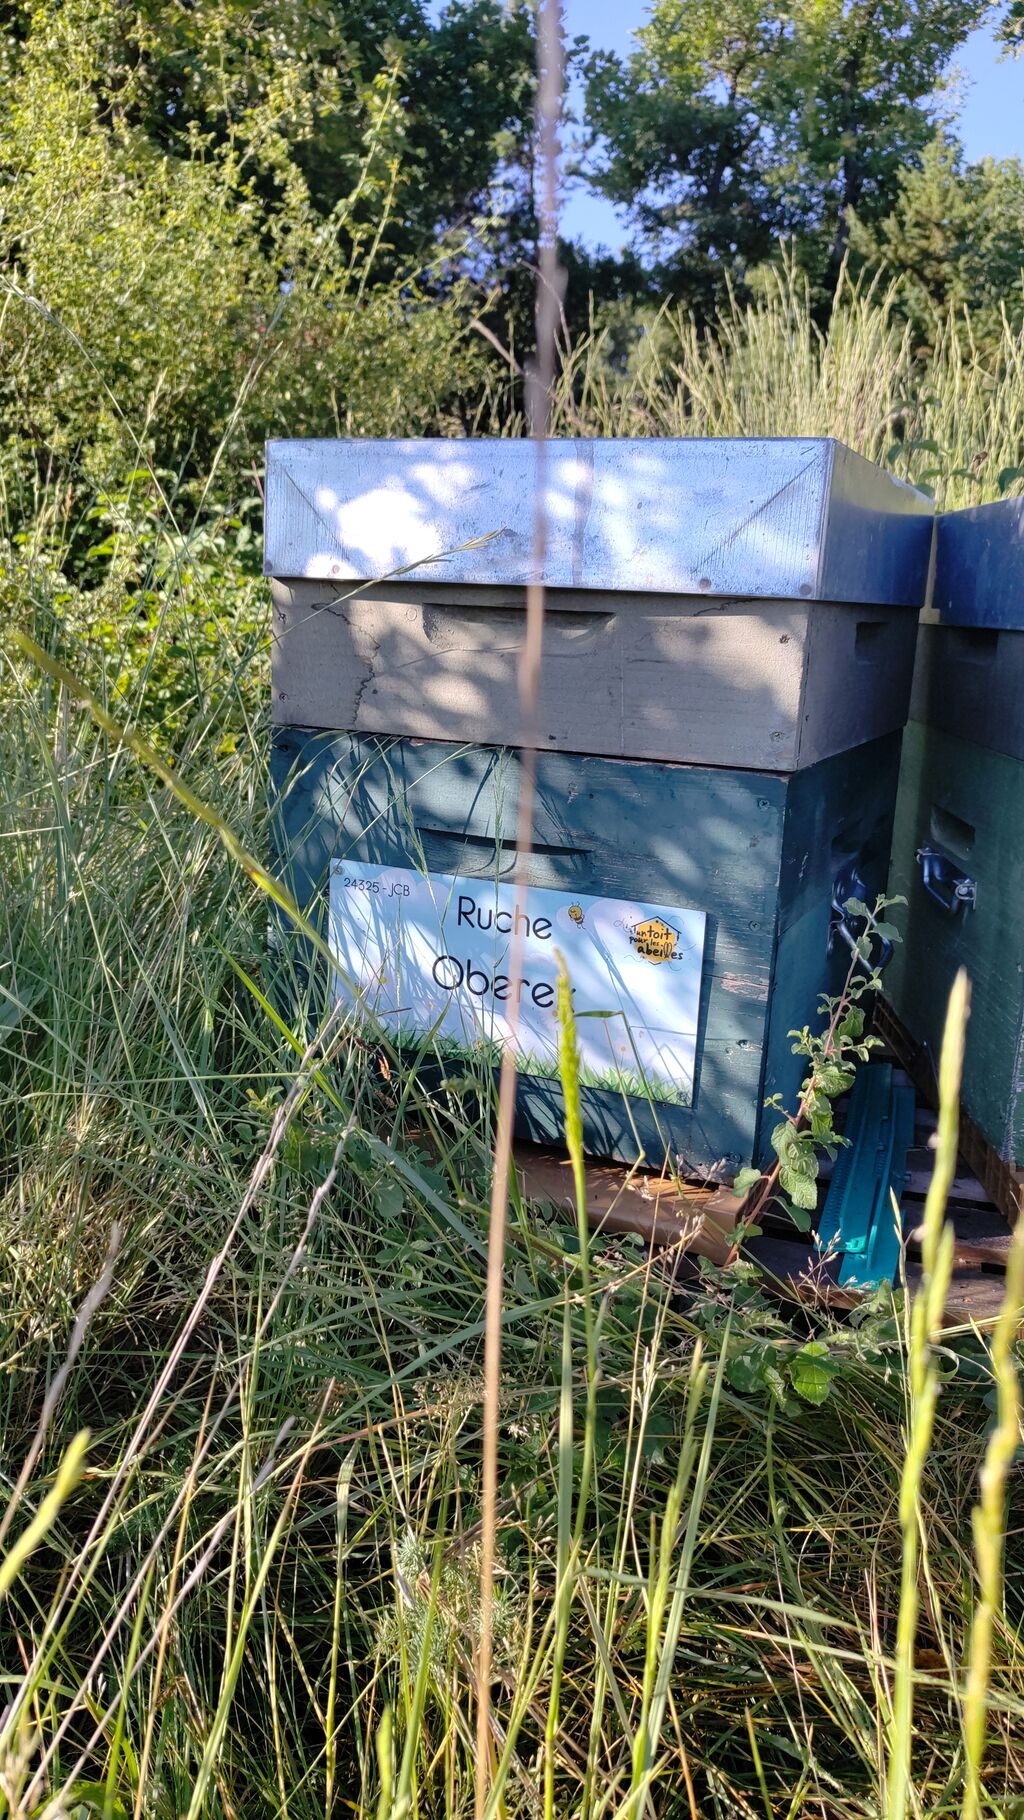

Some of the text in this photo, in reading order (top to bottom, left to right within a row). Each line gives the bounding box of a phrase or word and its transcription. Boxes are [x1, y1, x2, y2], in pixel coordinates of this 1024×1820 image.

[457, 895, 553, 940] Ruche
[629, 936, 648, 944] pour
[647, 925, 672, 940] toit
[637, 942, 683, 960] abeilles
[432, 955, 576, 1013] Obere
